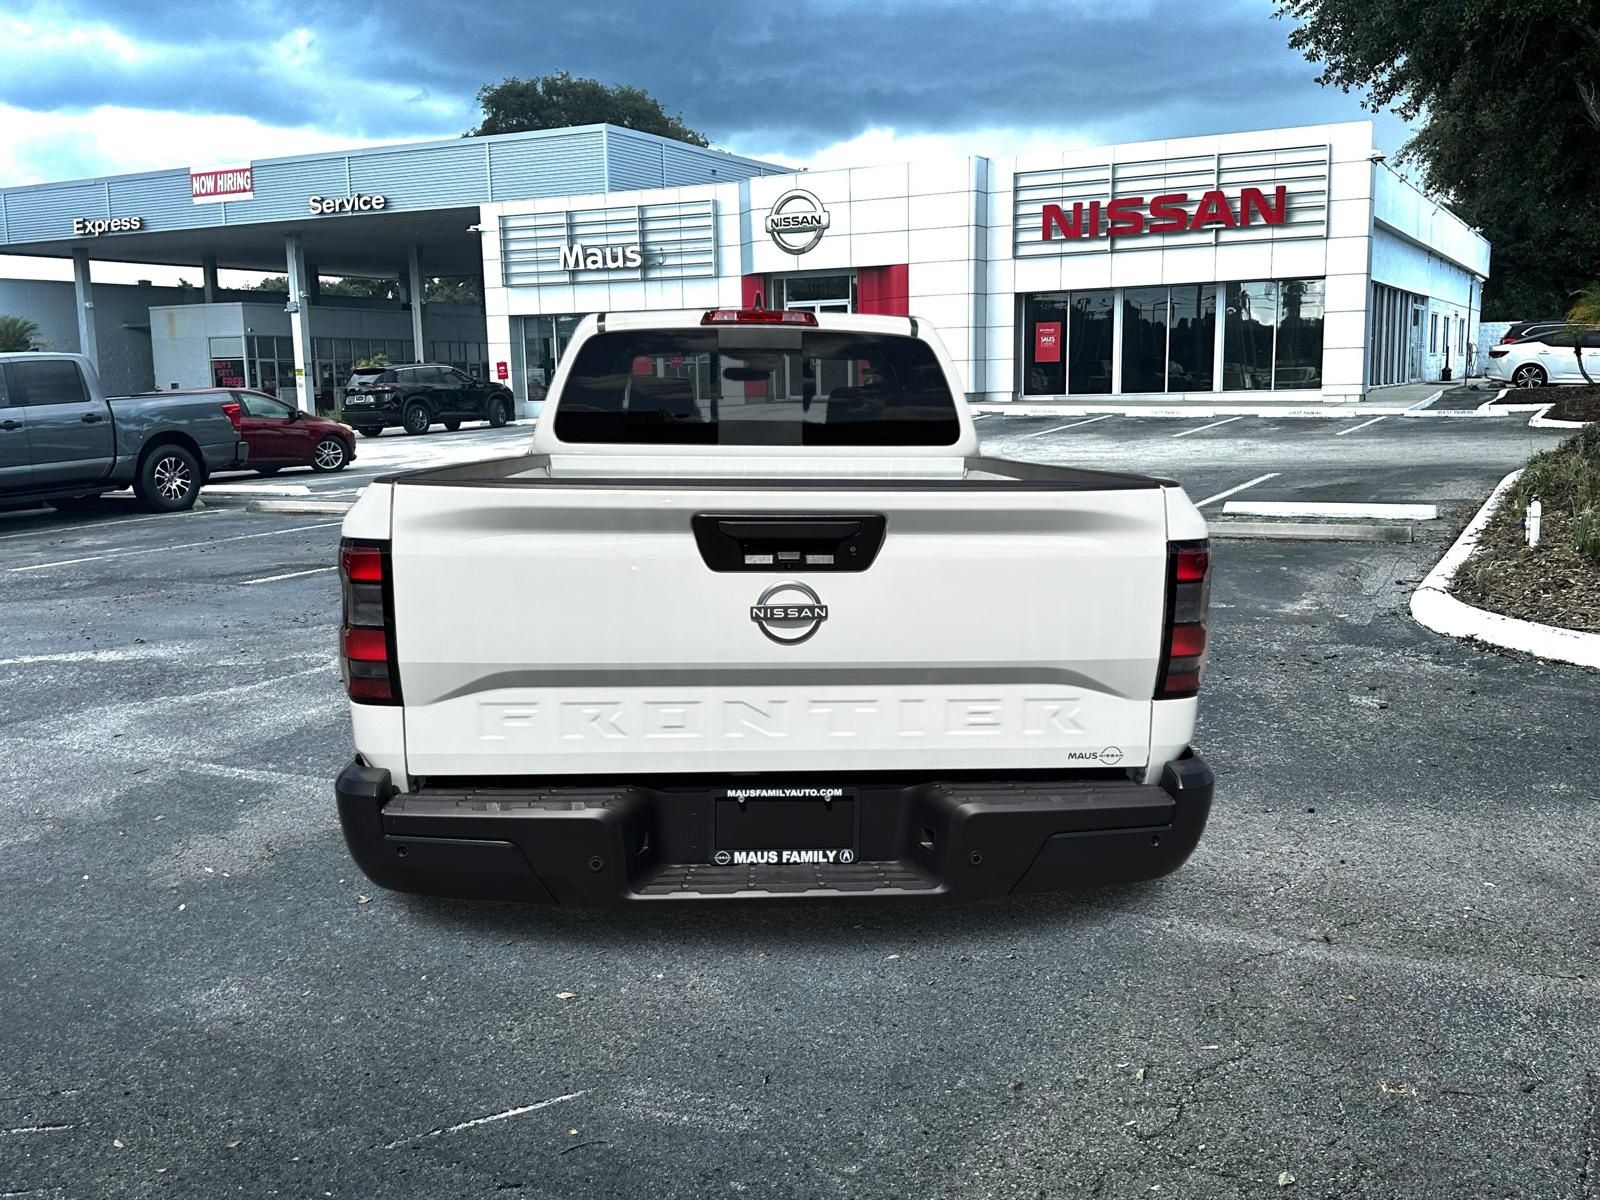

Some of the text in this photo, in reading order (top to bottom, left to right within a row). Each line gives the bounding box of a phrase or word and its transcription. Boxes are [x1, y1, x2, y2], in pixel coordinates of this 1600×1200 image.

[192, 171, 251, 195] NOW HIRING
[309, 192, 385, 215] Service
[770, 214, 822, 228] NISSAN
[1042, 185, 1287, 241] NISSAN
[72, 216, 141, 237] Express
[559, 243, 642, 270] Maus
[223, 376, 244, 387] FREE
[752, 606, 827, 618] NISSAN
[478, 697, 1087, 740] FRONTIER
[1067, 752, 1098, 760] MAUS
[727, 788, 843, 797] MAUSFAMILYAUTO.COM
[733, 850, 837, 864] MAUS FAMILY
